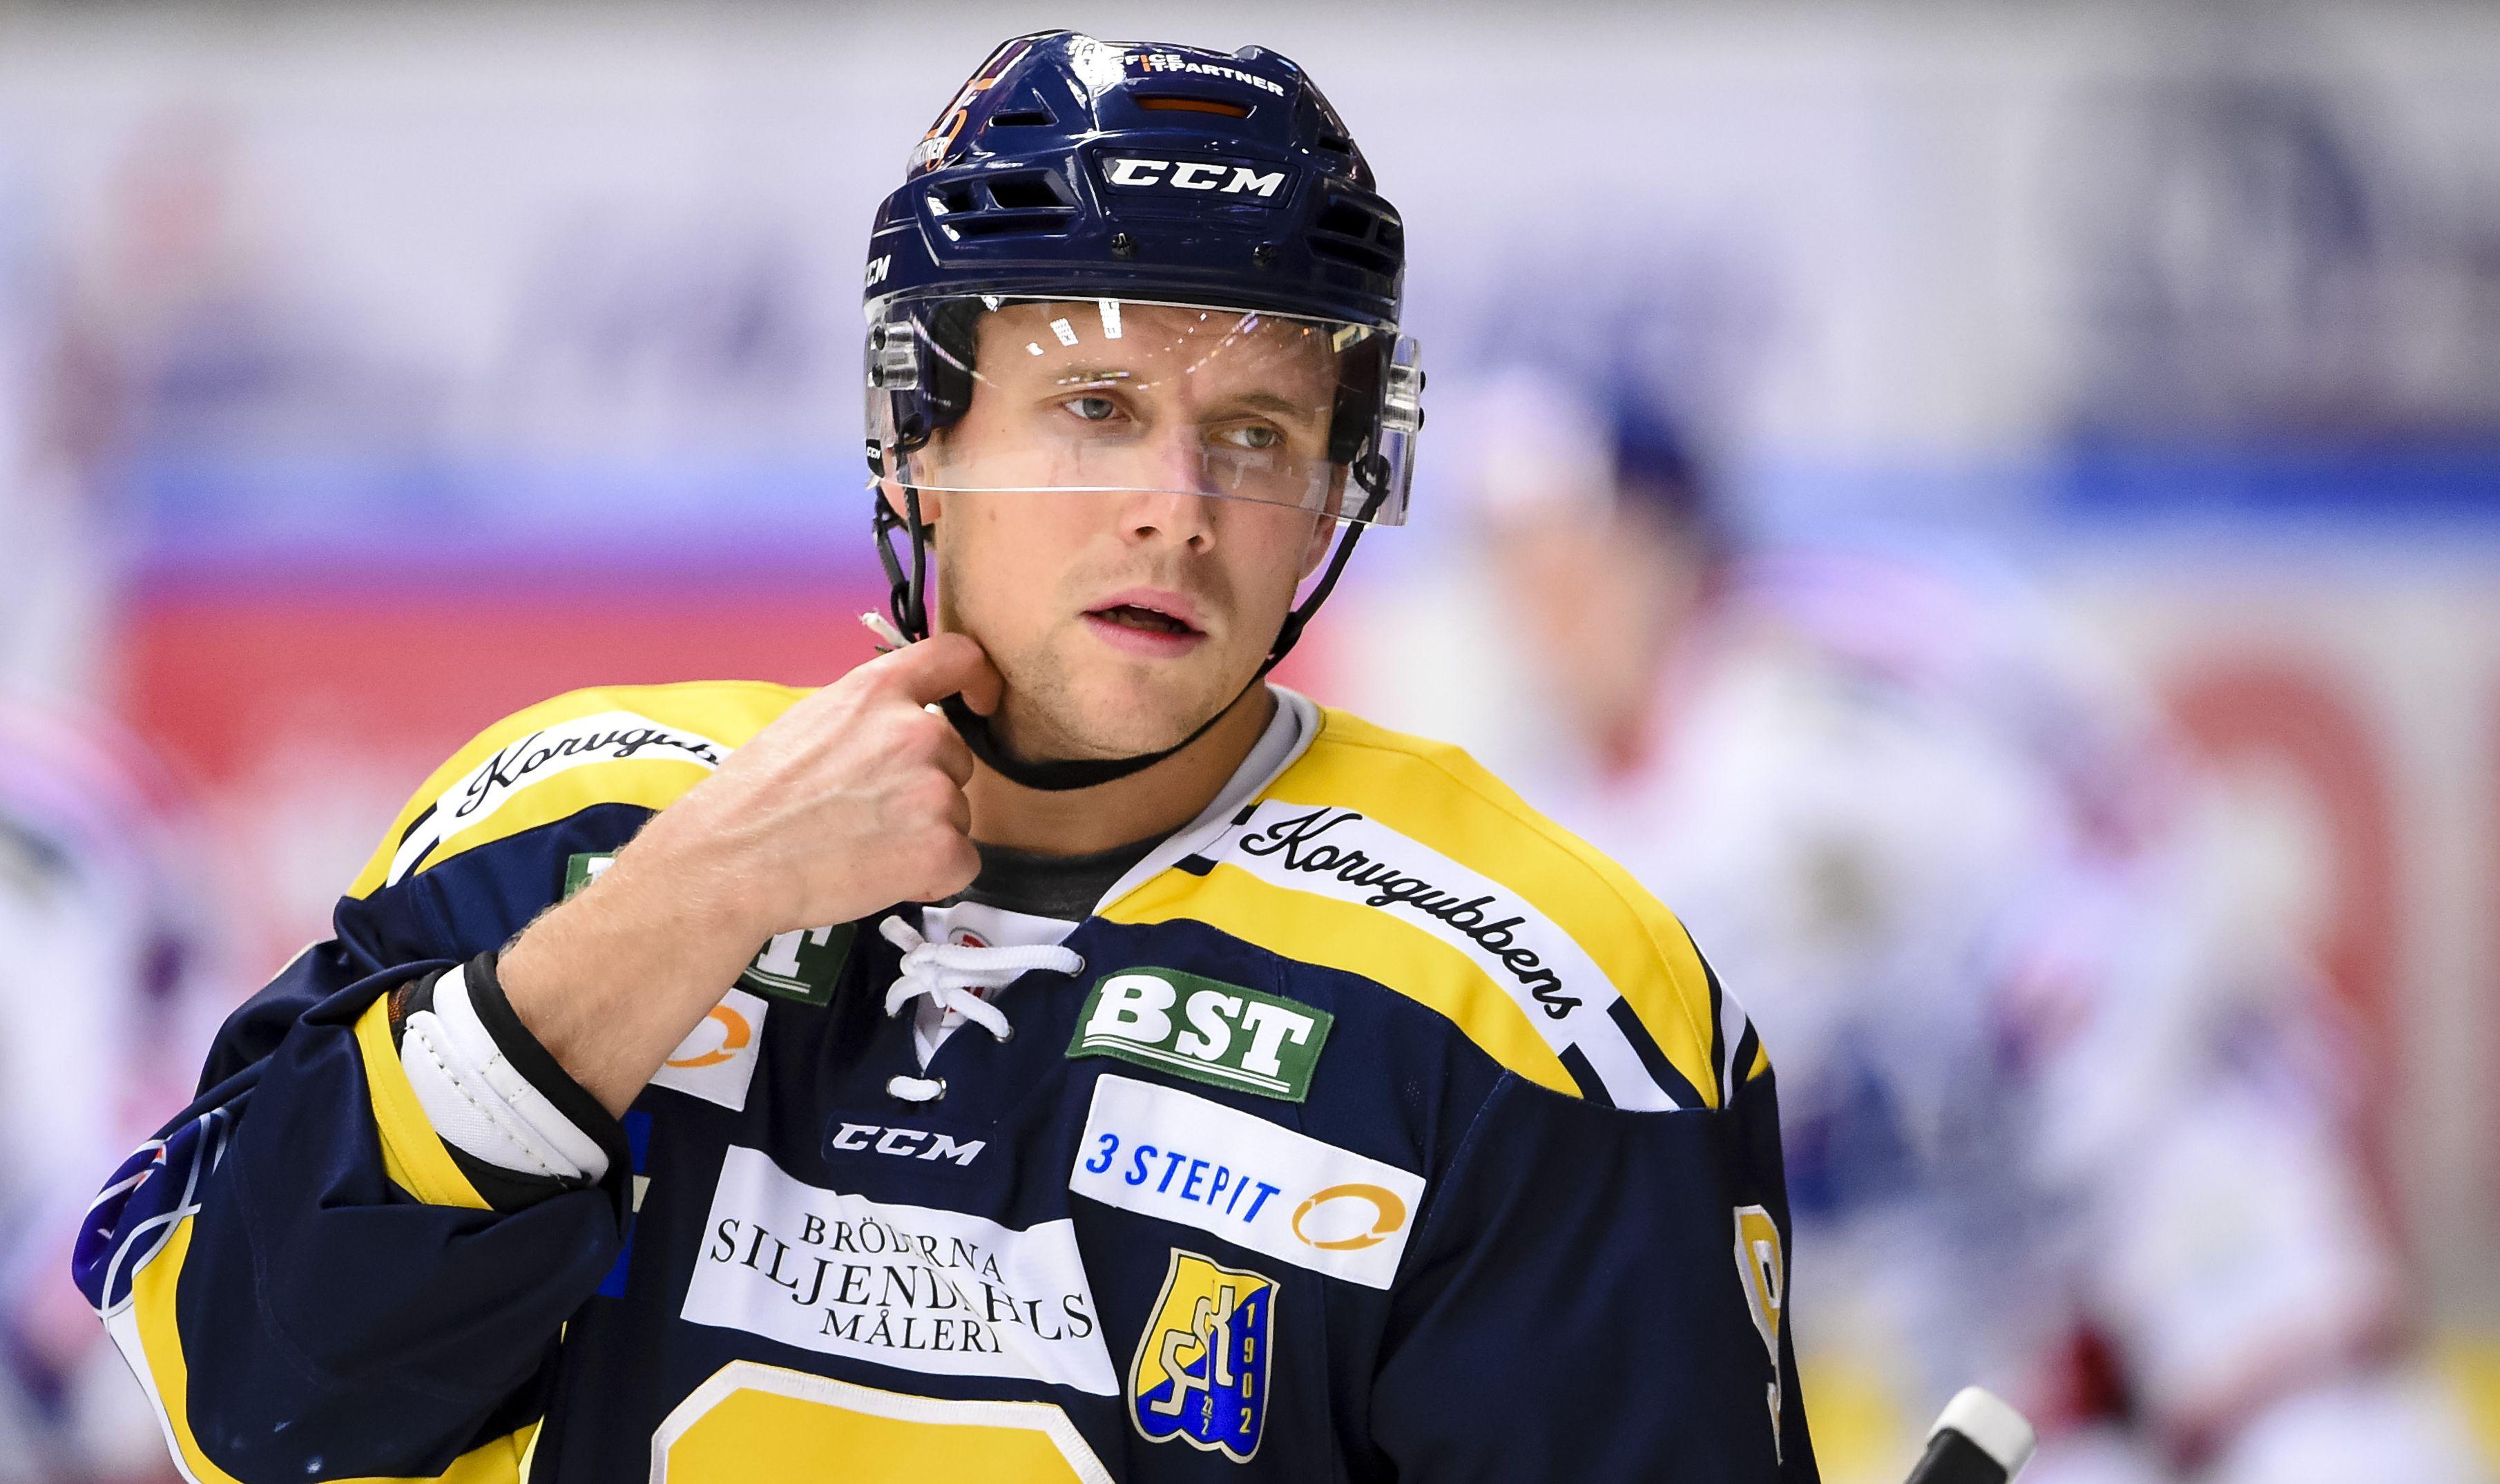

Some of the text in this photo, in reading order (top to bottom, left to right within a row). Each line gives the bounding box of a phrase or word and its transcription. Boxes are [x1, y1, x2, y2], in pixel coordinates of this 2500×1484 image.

[1110, 159, 1286, 197] CCM
[866, 254, 892, 287] CM
[1240, 807, 1583, 1020] Korvgubbens
[1085, 974, 1314, 1077] BST
[832, 1122, 986, 1166] CCM
[1086, 1133, 1119, 1175] 3
